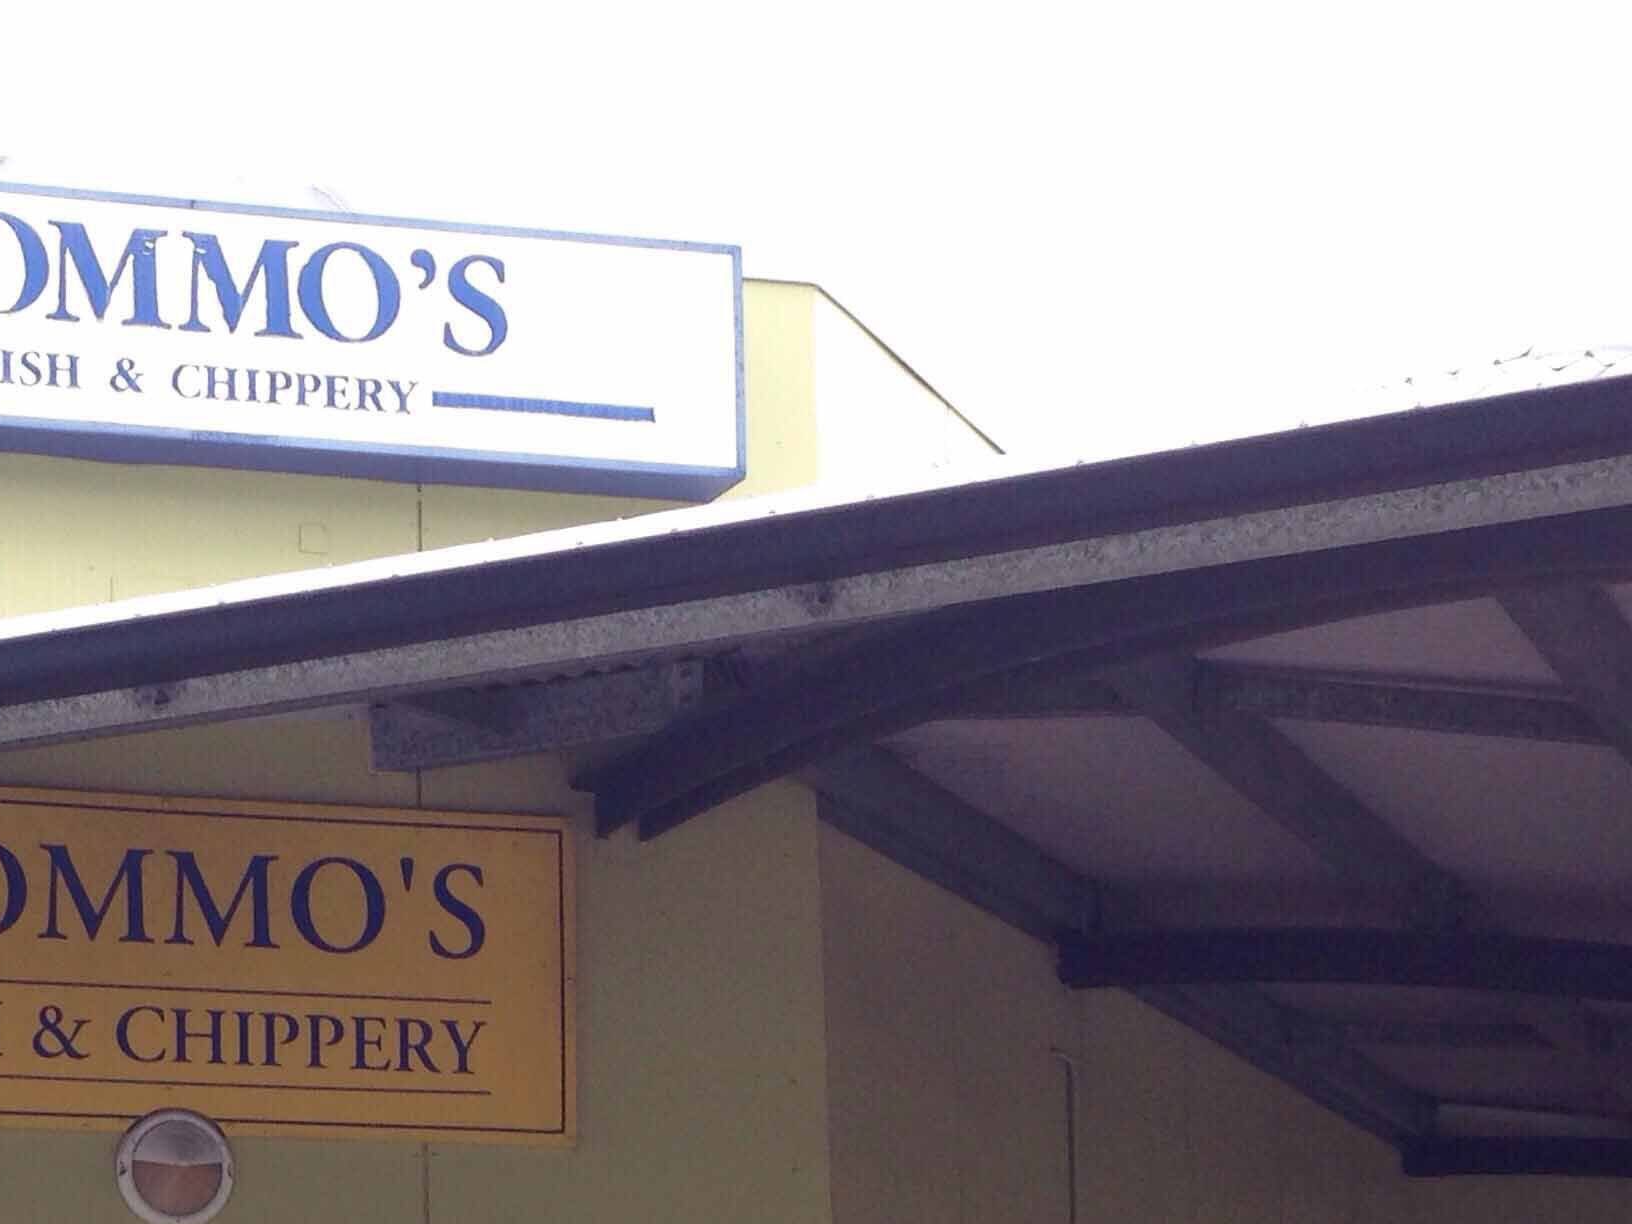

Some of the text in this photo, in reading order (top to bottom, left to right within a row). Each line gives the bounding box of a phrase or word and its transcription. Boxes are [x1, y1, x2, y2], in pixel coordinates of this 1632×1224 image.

[108, 359, 145, 395] &
[172, 363, 420, 416] CHIPPERY
[32, 1006, 91, 1060] &
[116, 1006, 487, 1075] CHIPPERY
